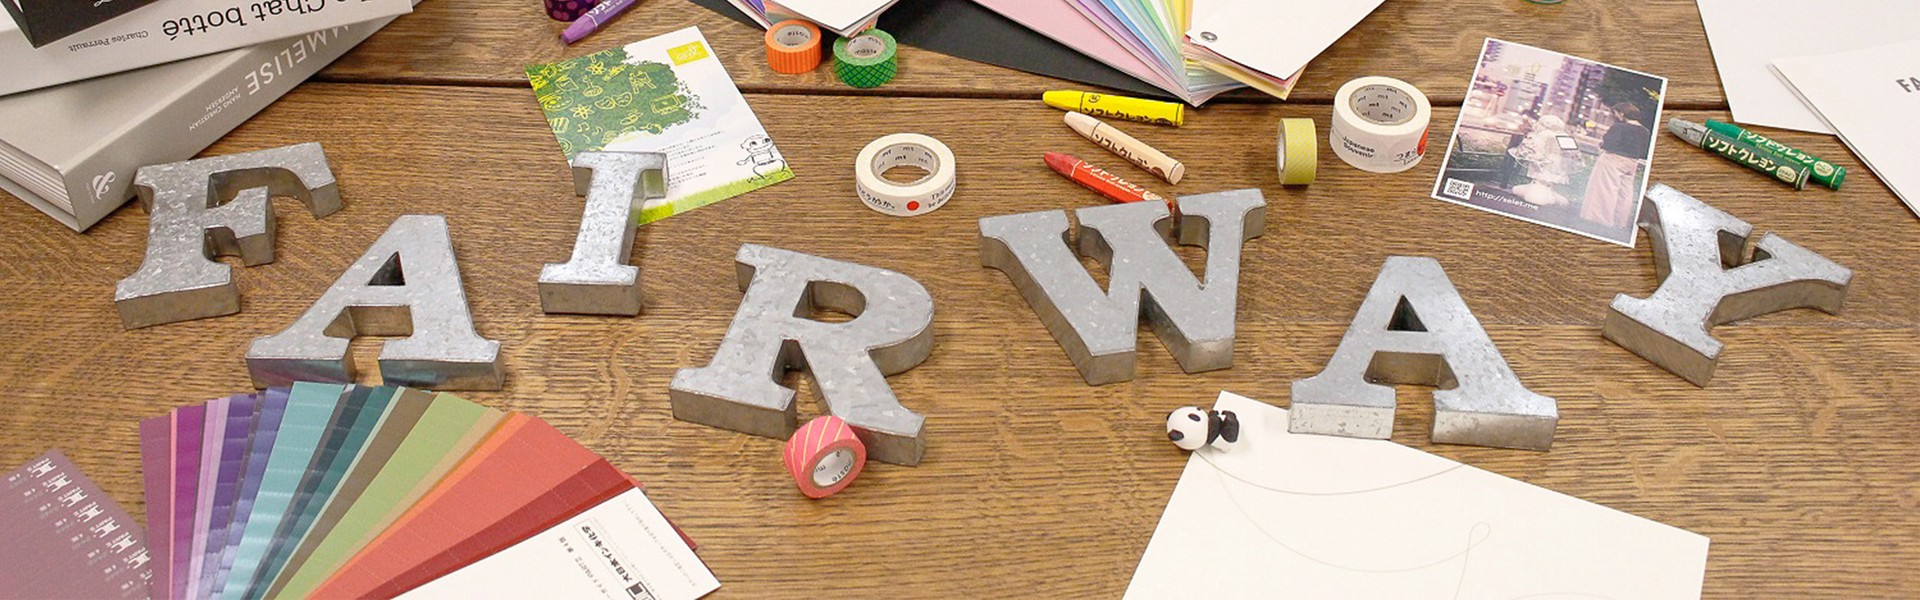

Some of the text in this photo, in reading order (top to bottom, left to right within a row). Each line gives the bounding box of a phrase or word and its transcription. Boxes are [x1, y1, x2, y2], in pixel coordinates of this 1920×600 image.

[162, 7, 246, 42] botté
[68, 30, 148, 53] Charles Perrault
[245, 25, 350, 96] MELISE
[1342, 136, 1375, 152] Japanese
[1343, 143, 1374, 158] Souvenir
[1708, 136, 1777, 172] ソフトクレヨン
